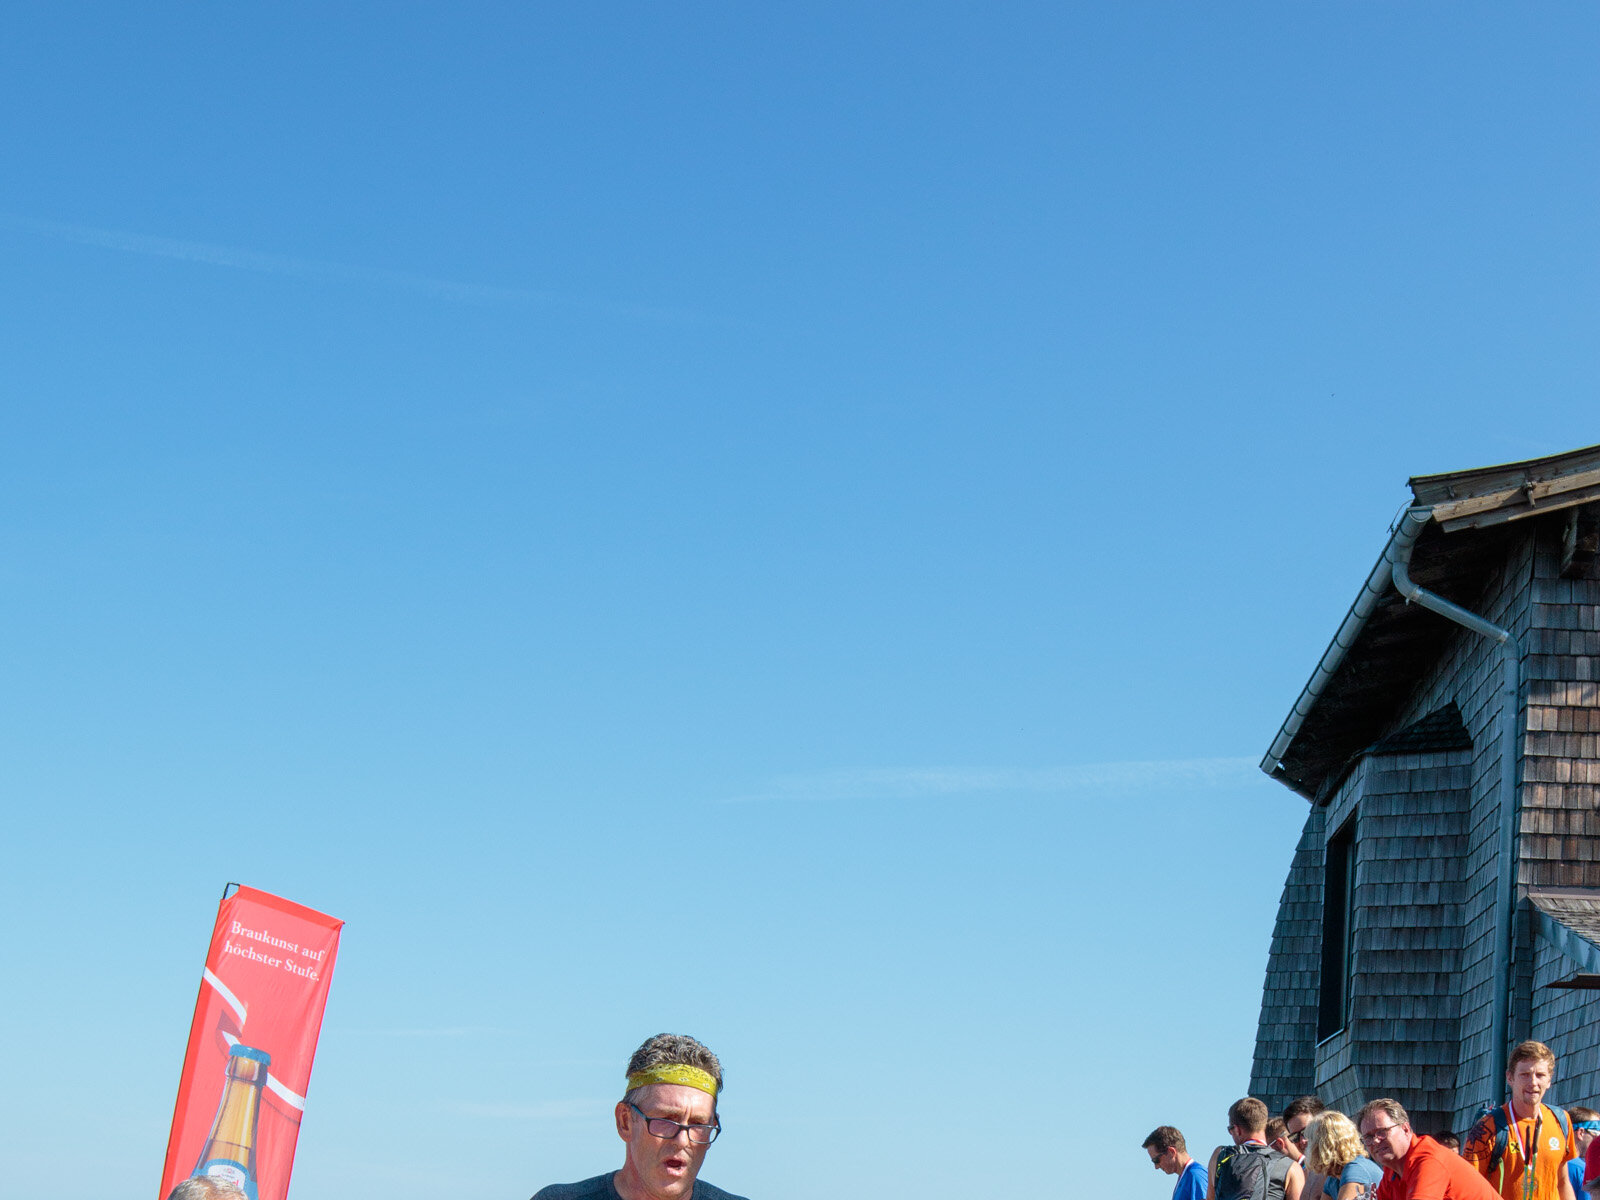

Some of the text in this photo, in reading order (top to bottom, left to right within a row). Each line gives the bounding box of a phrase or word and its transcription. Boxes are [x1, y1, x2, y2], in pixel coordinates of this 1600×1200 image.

[224, 940, 320, 982] höchster Stufe.
[231, 920, 326, 962] Braukunst auf
